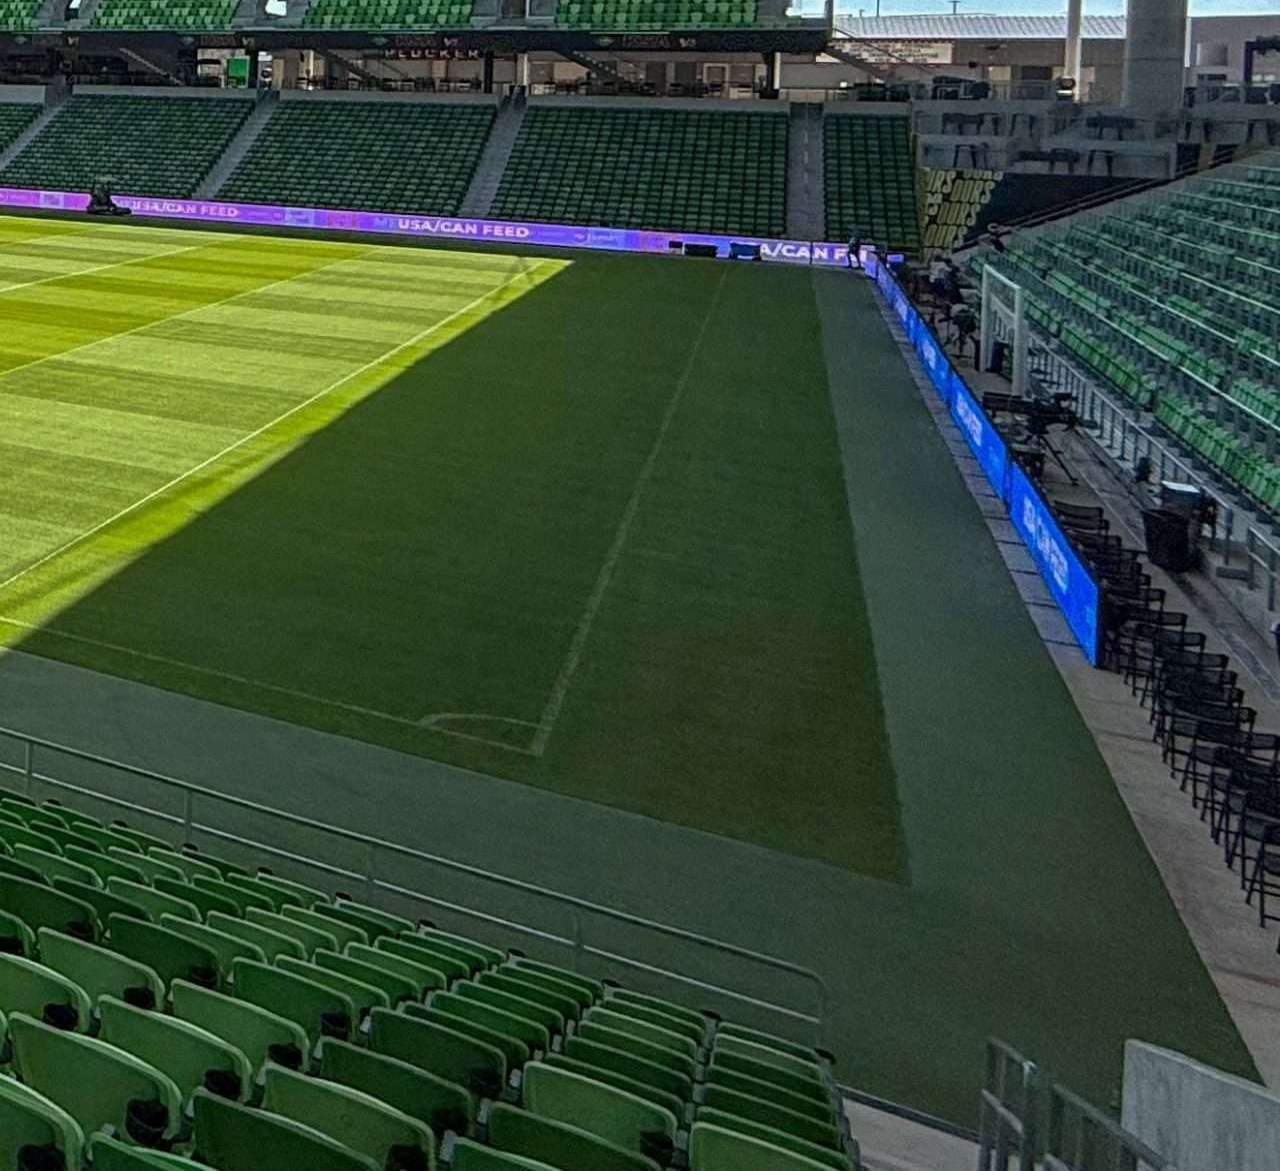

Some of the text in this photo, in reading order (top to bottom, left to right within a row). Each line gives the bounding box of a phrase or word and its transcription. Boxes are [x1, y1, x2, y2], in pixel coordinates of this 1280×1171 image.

[950, 179, 995, 204] OURS
[200, 204, 239, 217] FEED
[398, 218, 529, 239] USA/CAN FEED
[760, 242, 828, 260] A/CAN
